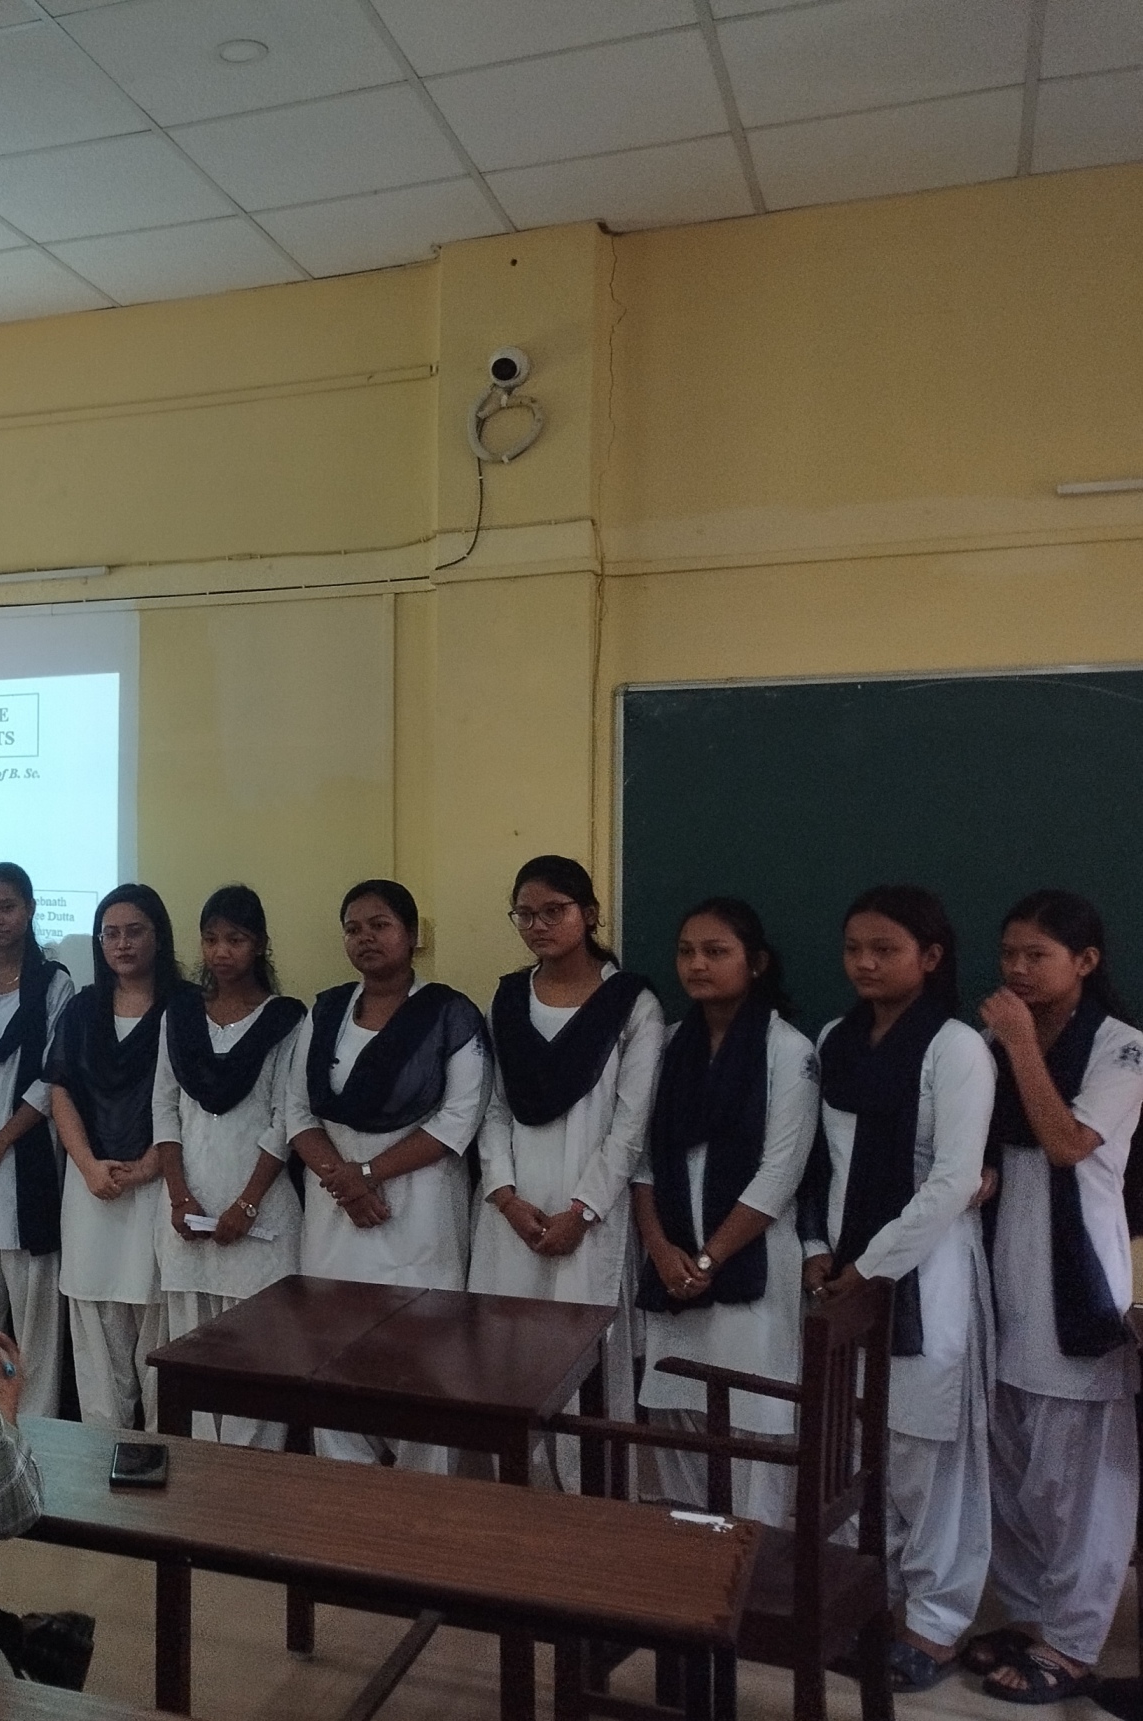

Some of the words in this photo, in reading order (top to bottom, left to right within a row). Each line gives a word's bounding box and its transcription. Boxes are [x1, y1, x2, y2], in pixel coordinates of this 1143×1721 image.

[8, 768, 20, 779] B.
[24, 768, 40, 779] Sc.
[36, 896, 66, 906] ebnath
[47, 911, 75, 921] Dutta
